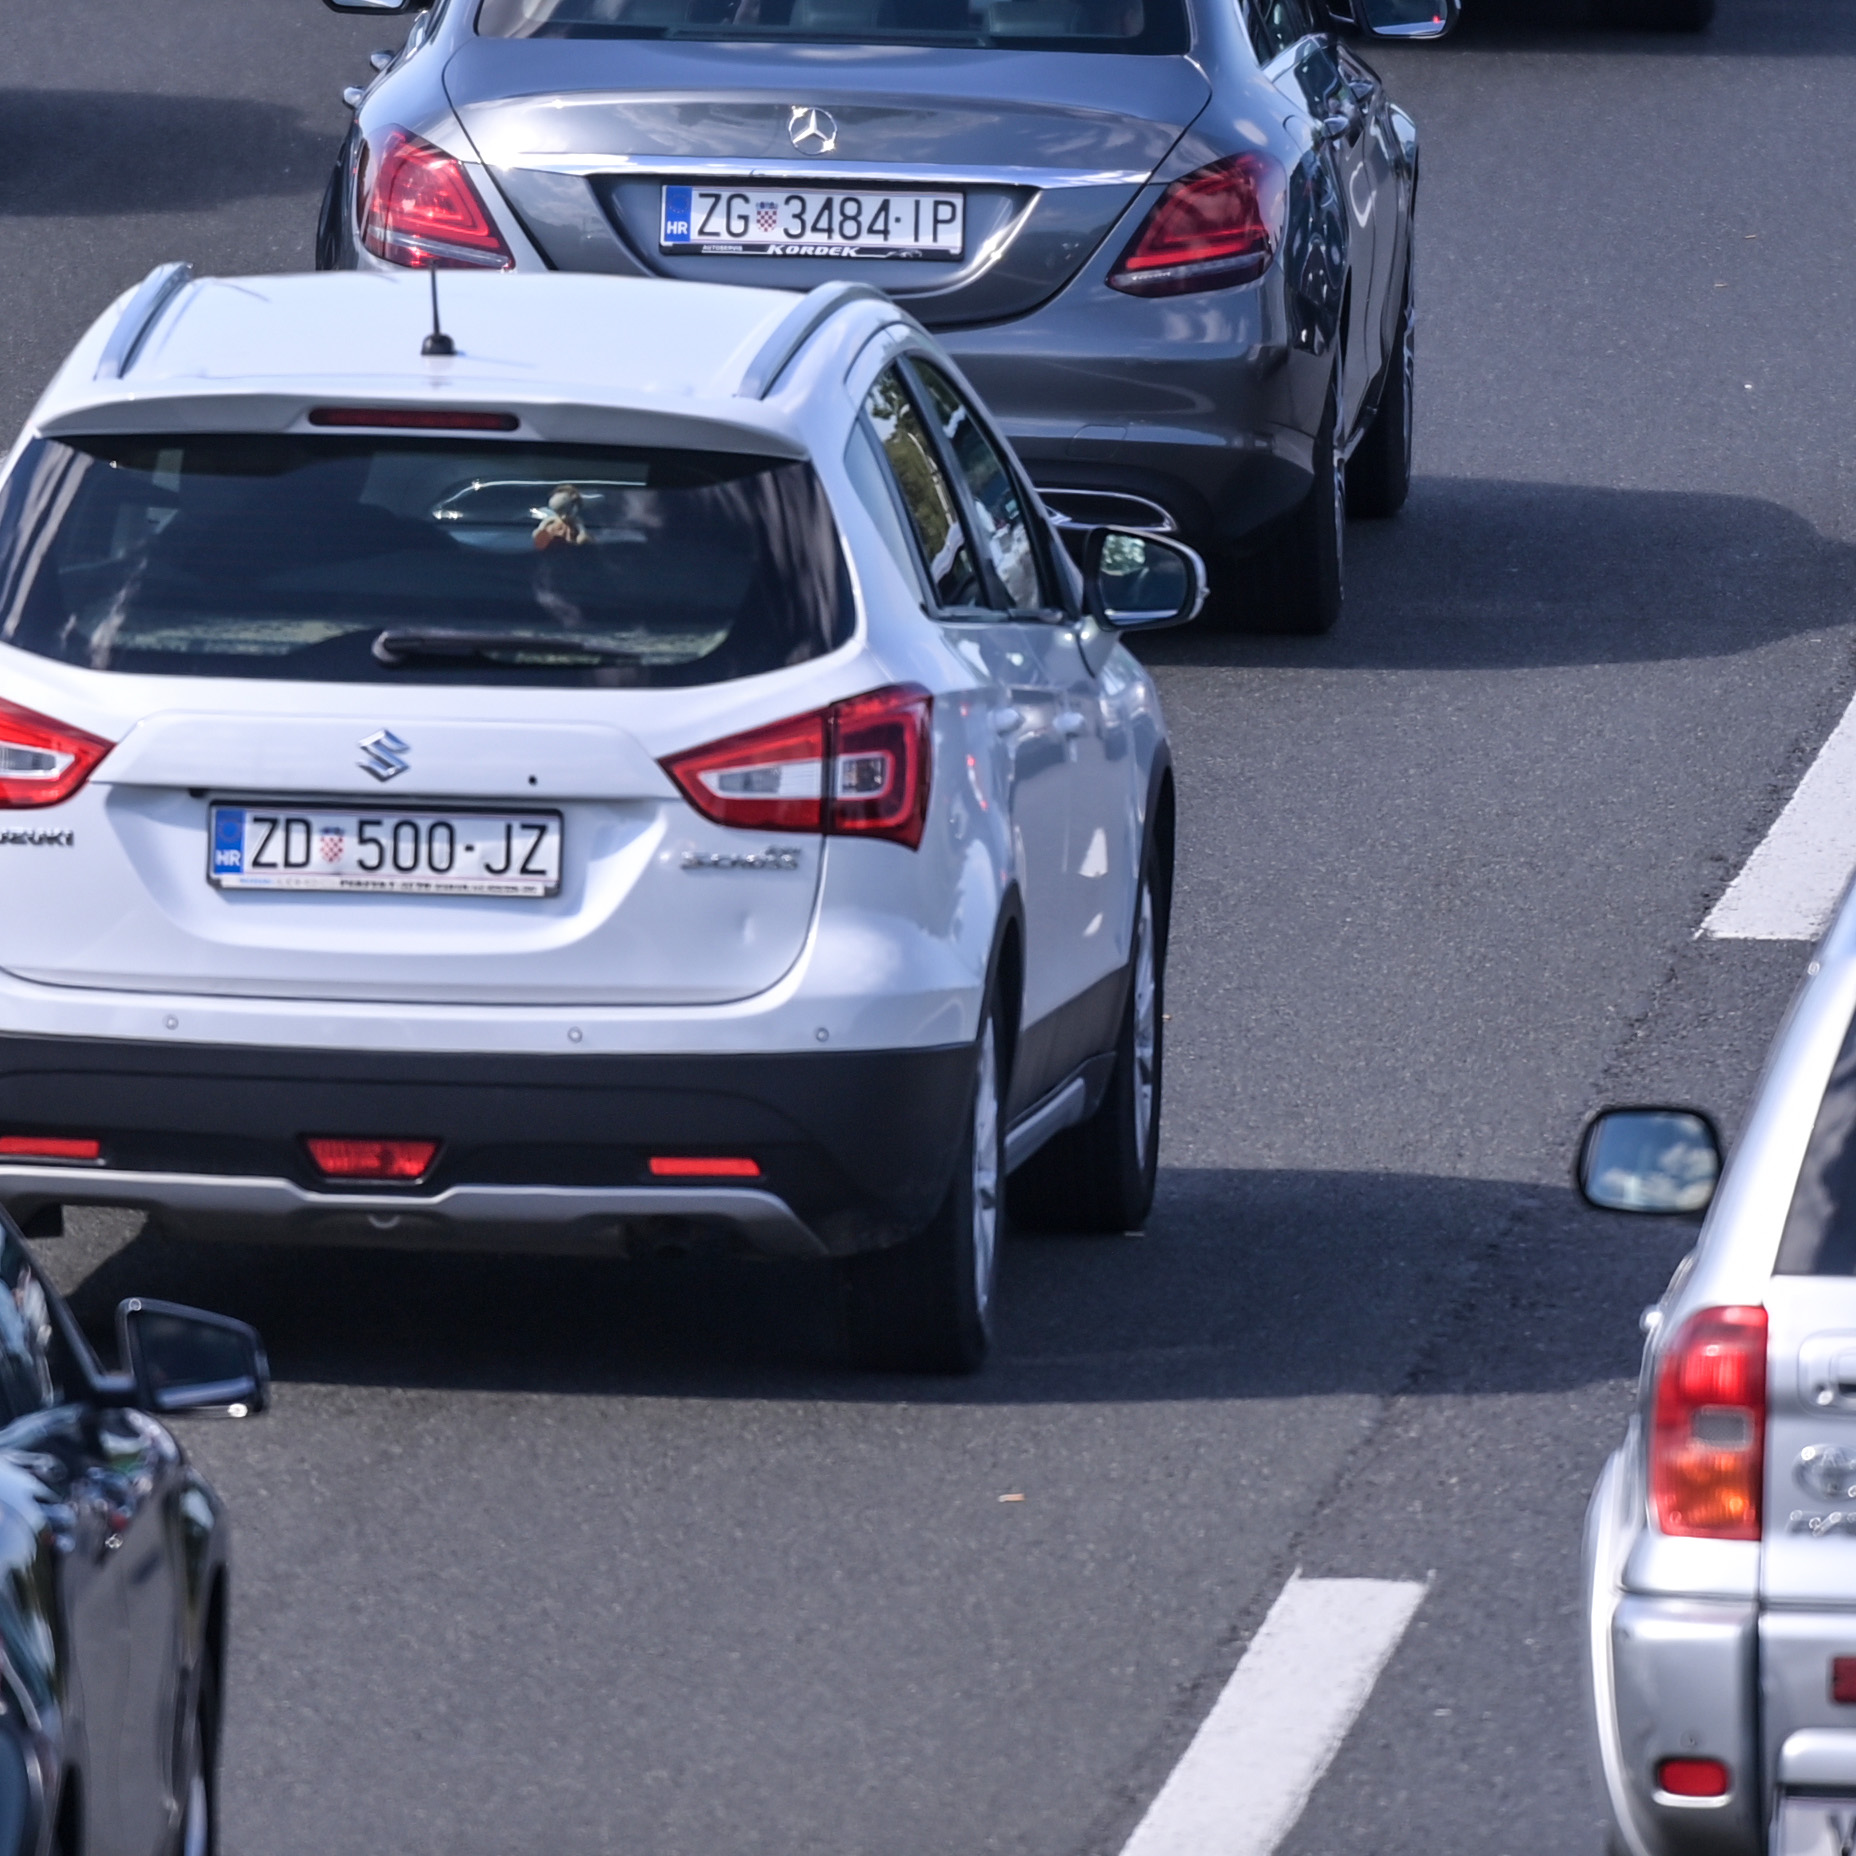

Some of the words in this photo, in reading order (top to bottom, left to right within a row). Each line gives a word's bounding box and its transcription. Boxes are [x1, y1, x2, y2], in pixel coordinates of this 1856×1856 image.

[697, 191, 751, 238] ZG
[782, 194, 958, 243] 3484-IP
[666, 221, 689, 235] HR
[766, 245, 861, 257] KORDEK
[251, 816, 312, 869] ZD
[356, 819, 551, 876] 500-JZ
[216, 850, 242, 867] HR
